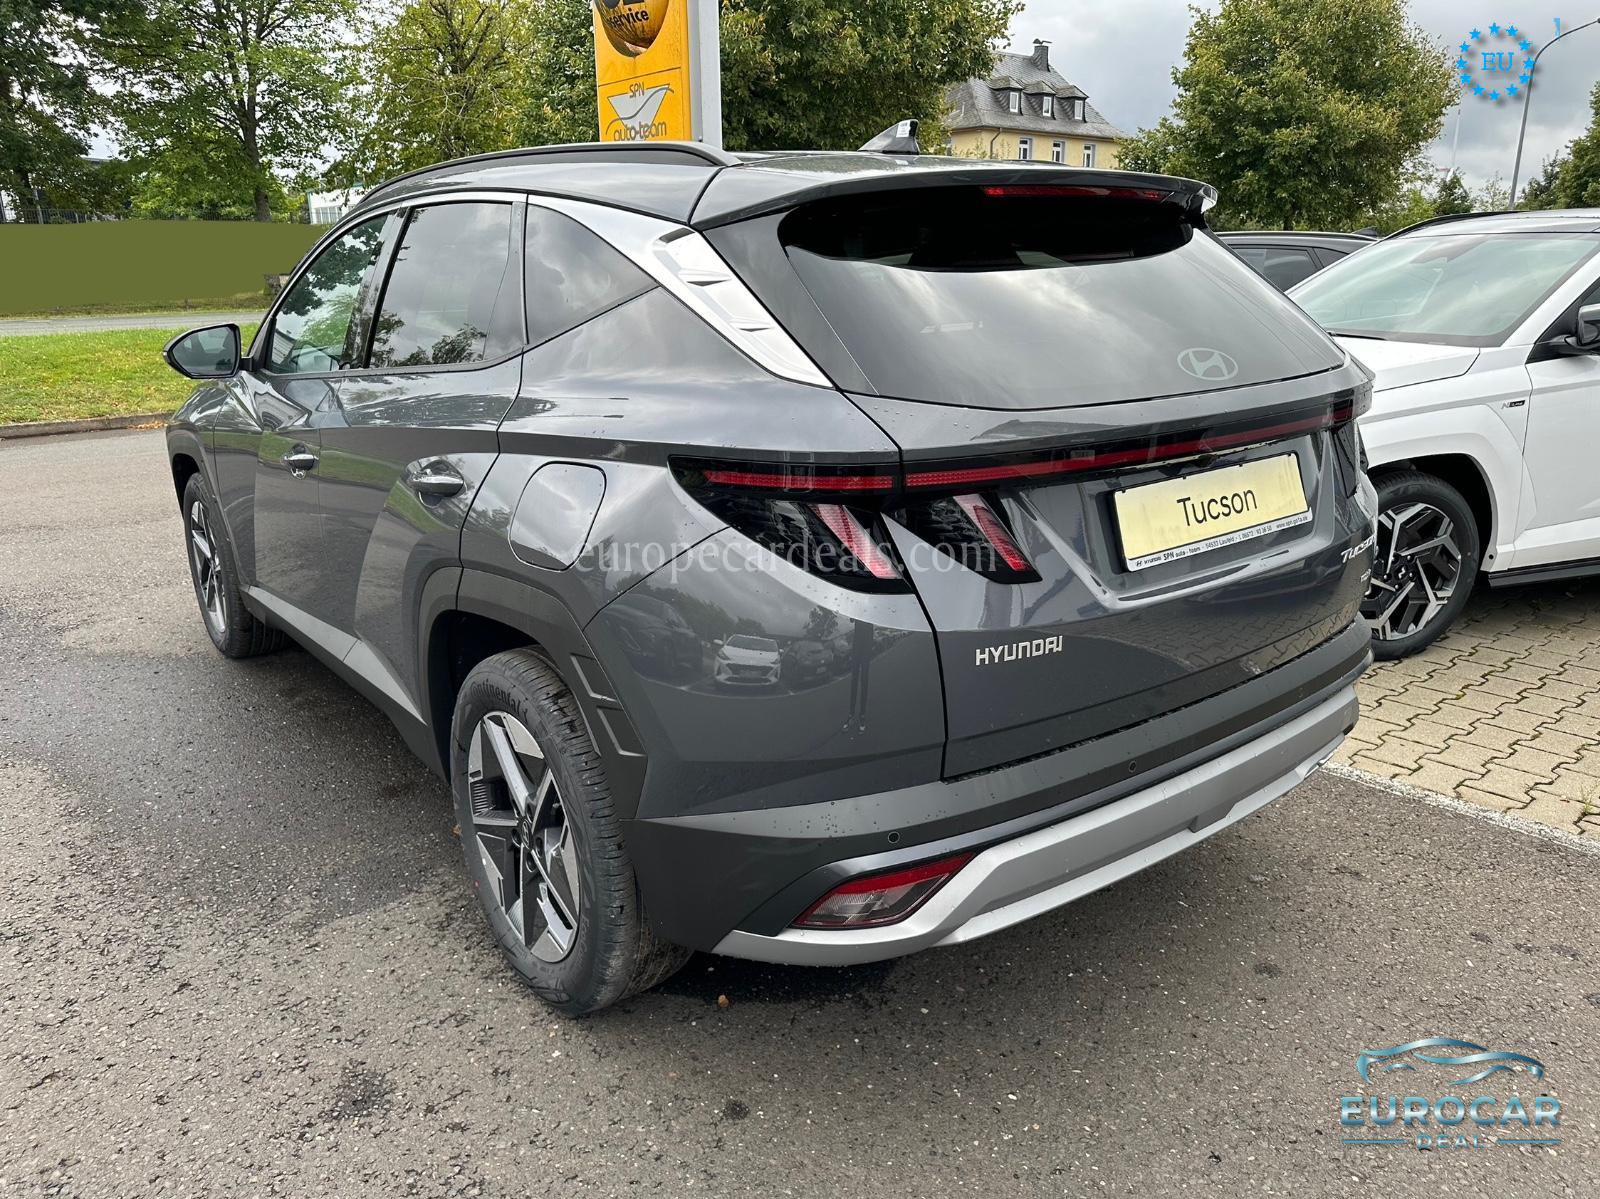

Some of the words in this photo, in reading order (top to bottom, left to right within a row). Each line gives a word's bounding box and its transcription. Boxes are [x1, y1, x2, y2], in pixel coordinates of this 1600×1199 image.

[607, 8, 649, 28] service
[629, 82, 645, 98] SPN
[613, 121, 667, 141] auto-team
[1176, 489, 1258, 527] Tucson
[1163, 551, 1175, 561] SPN
[976, 635, 1063, 666] HYUNDAI
[471, 678, 521, 717] Continental
